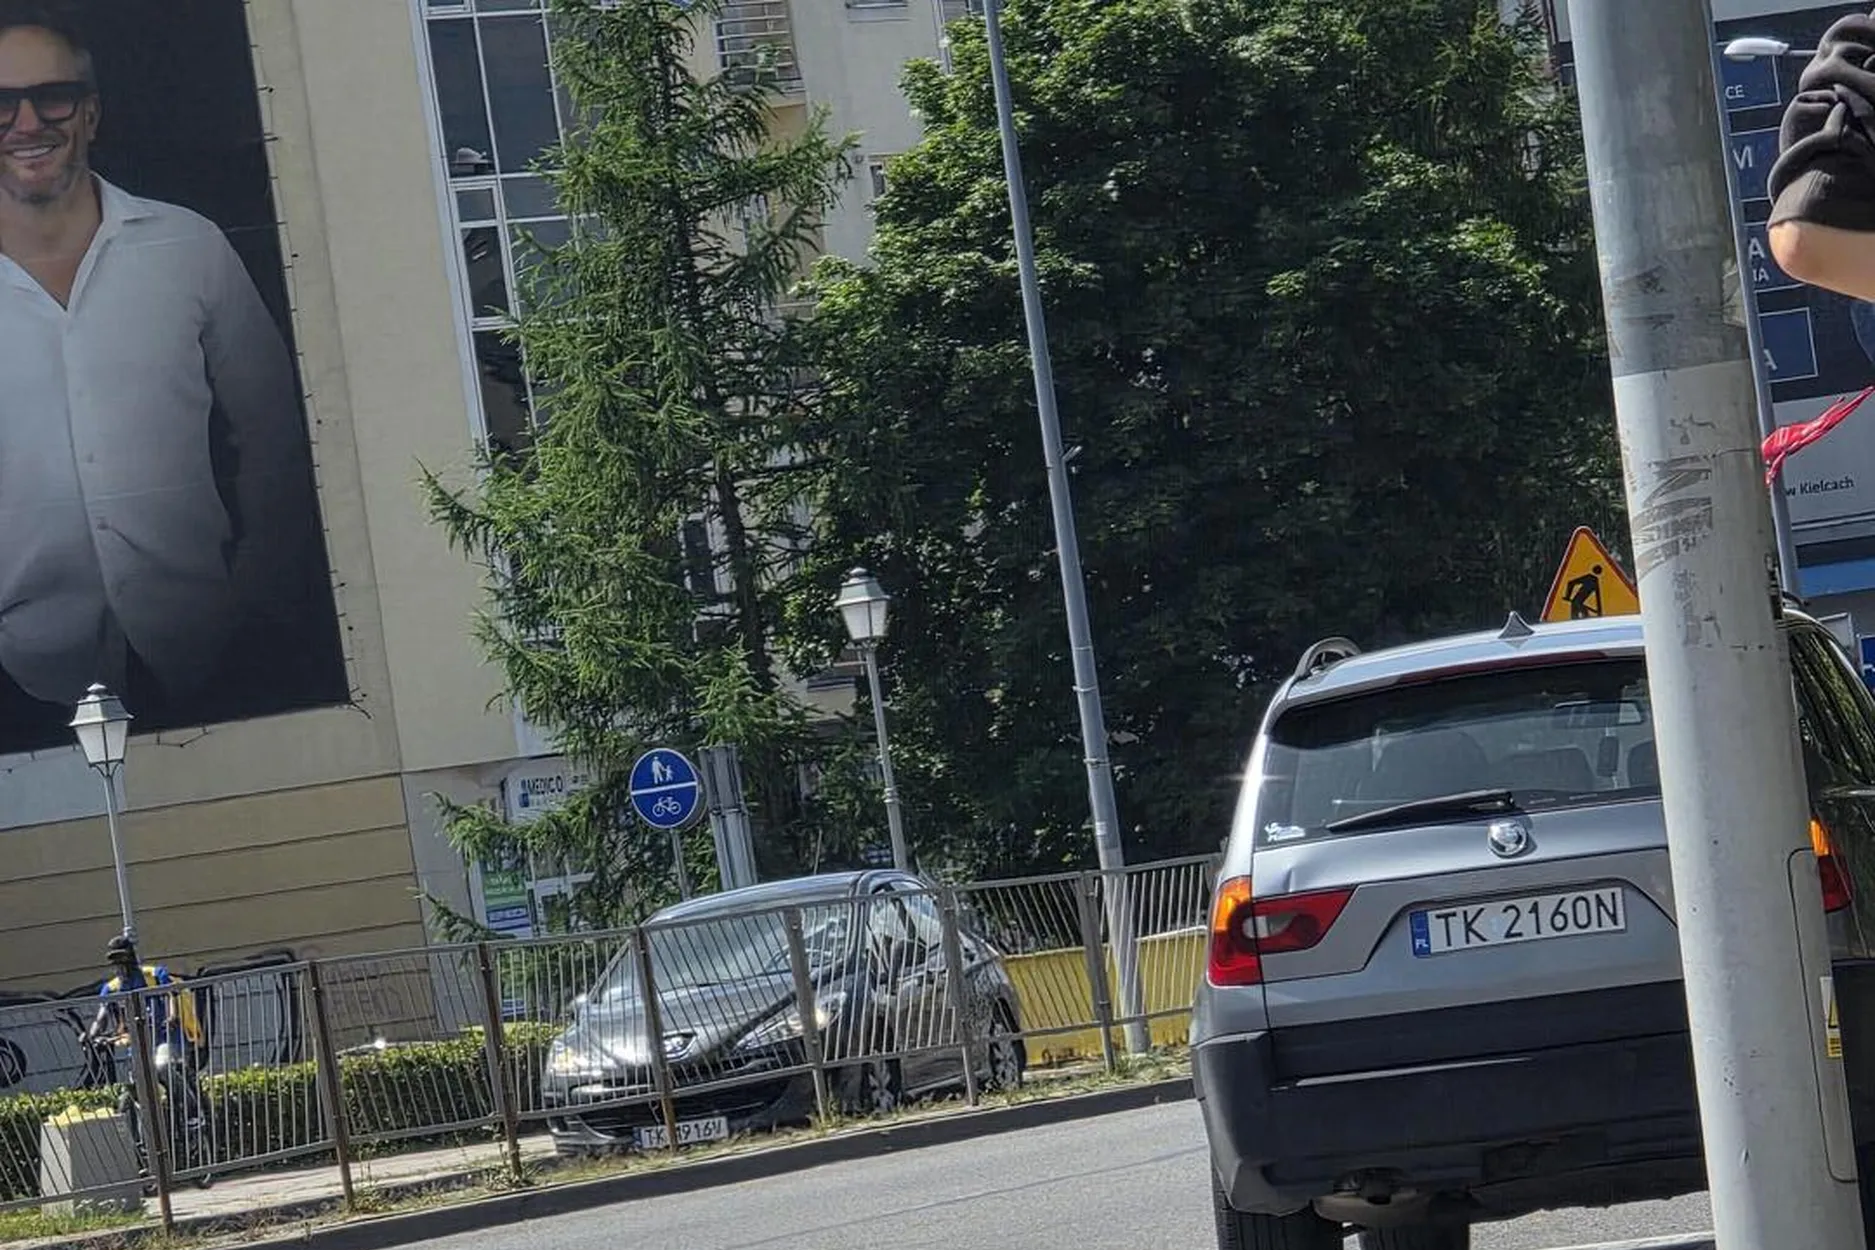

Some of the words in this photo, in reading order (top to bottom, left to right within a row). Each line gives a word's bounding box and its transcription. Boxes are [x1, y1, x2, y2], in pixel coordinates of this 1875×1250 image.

[1800, 475, 1855, 494] Kielcach
[1435, 907, 1488, 947] TK
[1502, 891, 1619, 939] 2160N
